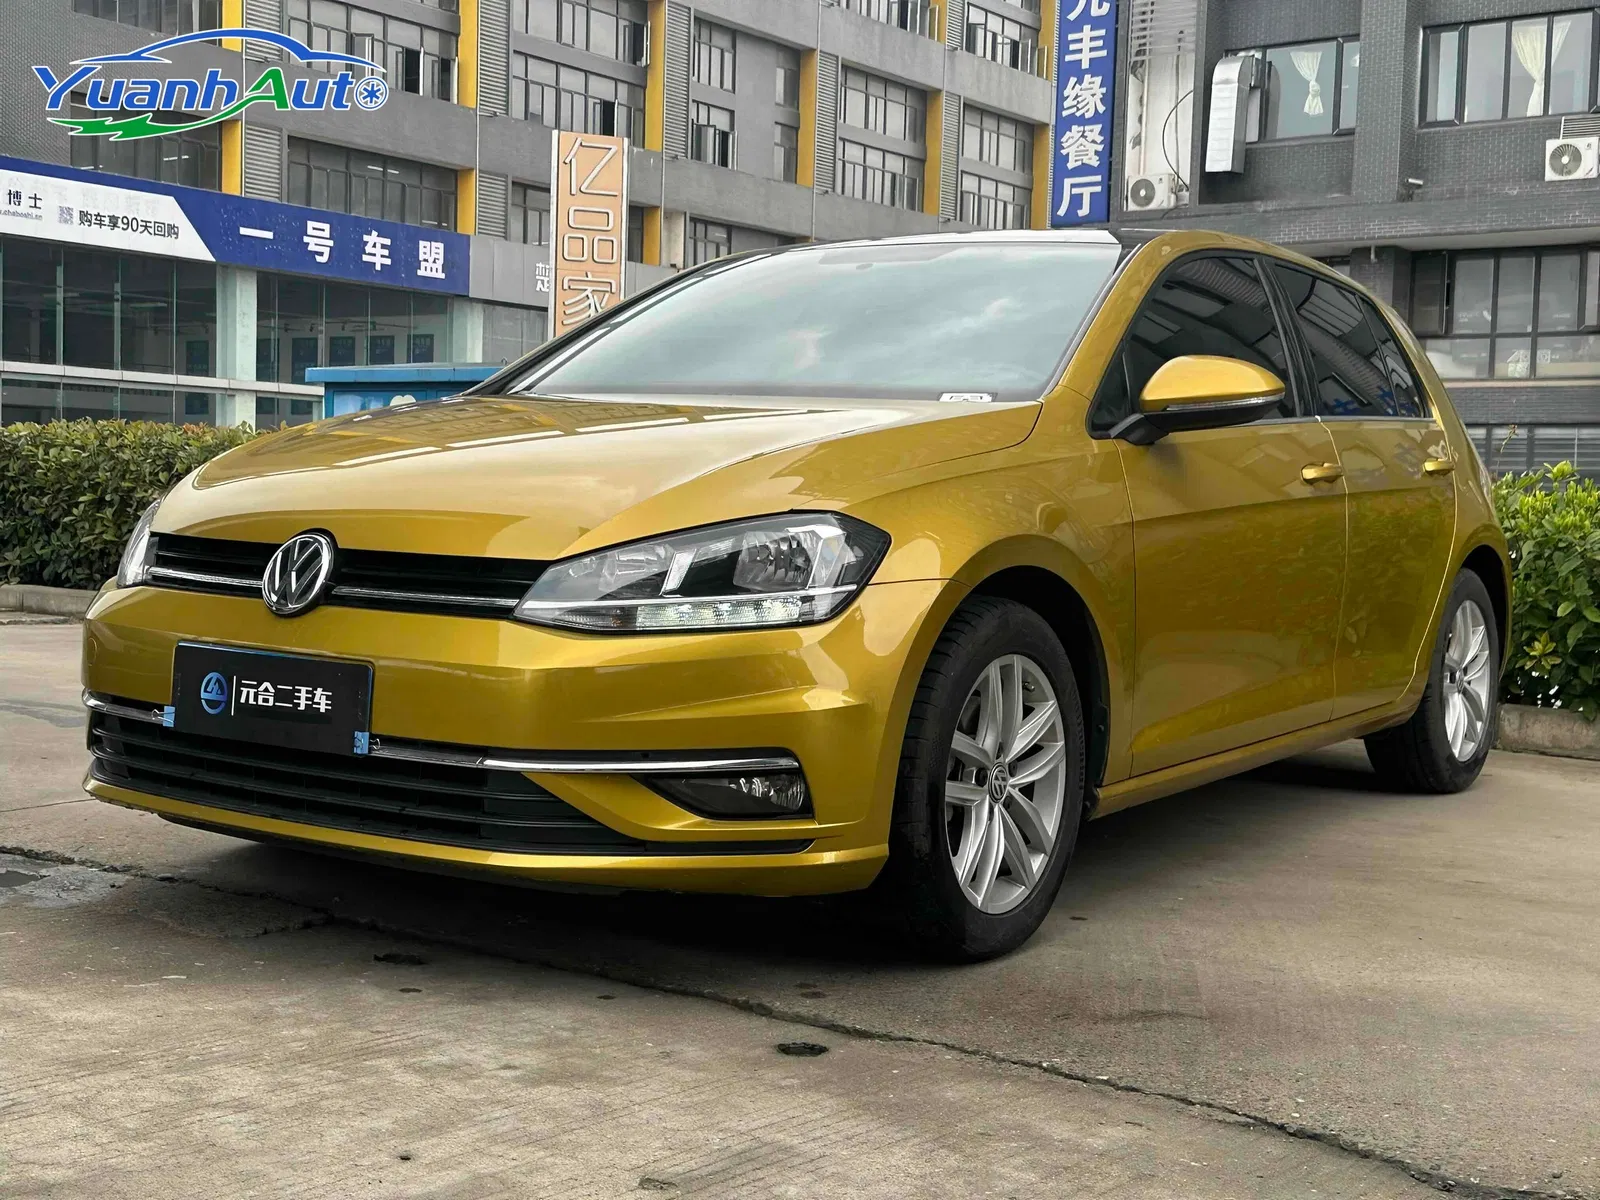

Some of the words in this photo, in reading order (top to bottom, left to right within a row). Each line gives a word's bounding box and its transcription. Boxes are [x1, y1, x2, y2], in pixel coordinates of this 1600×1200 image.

[78, 210, 180, 240] 购车享90天回购
[562, 137, 619, 326] 亿品家
[239, 220, 446, 279] 一号车盟
[240, 679, 332, 713] 元合二手车
